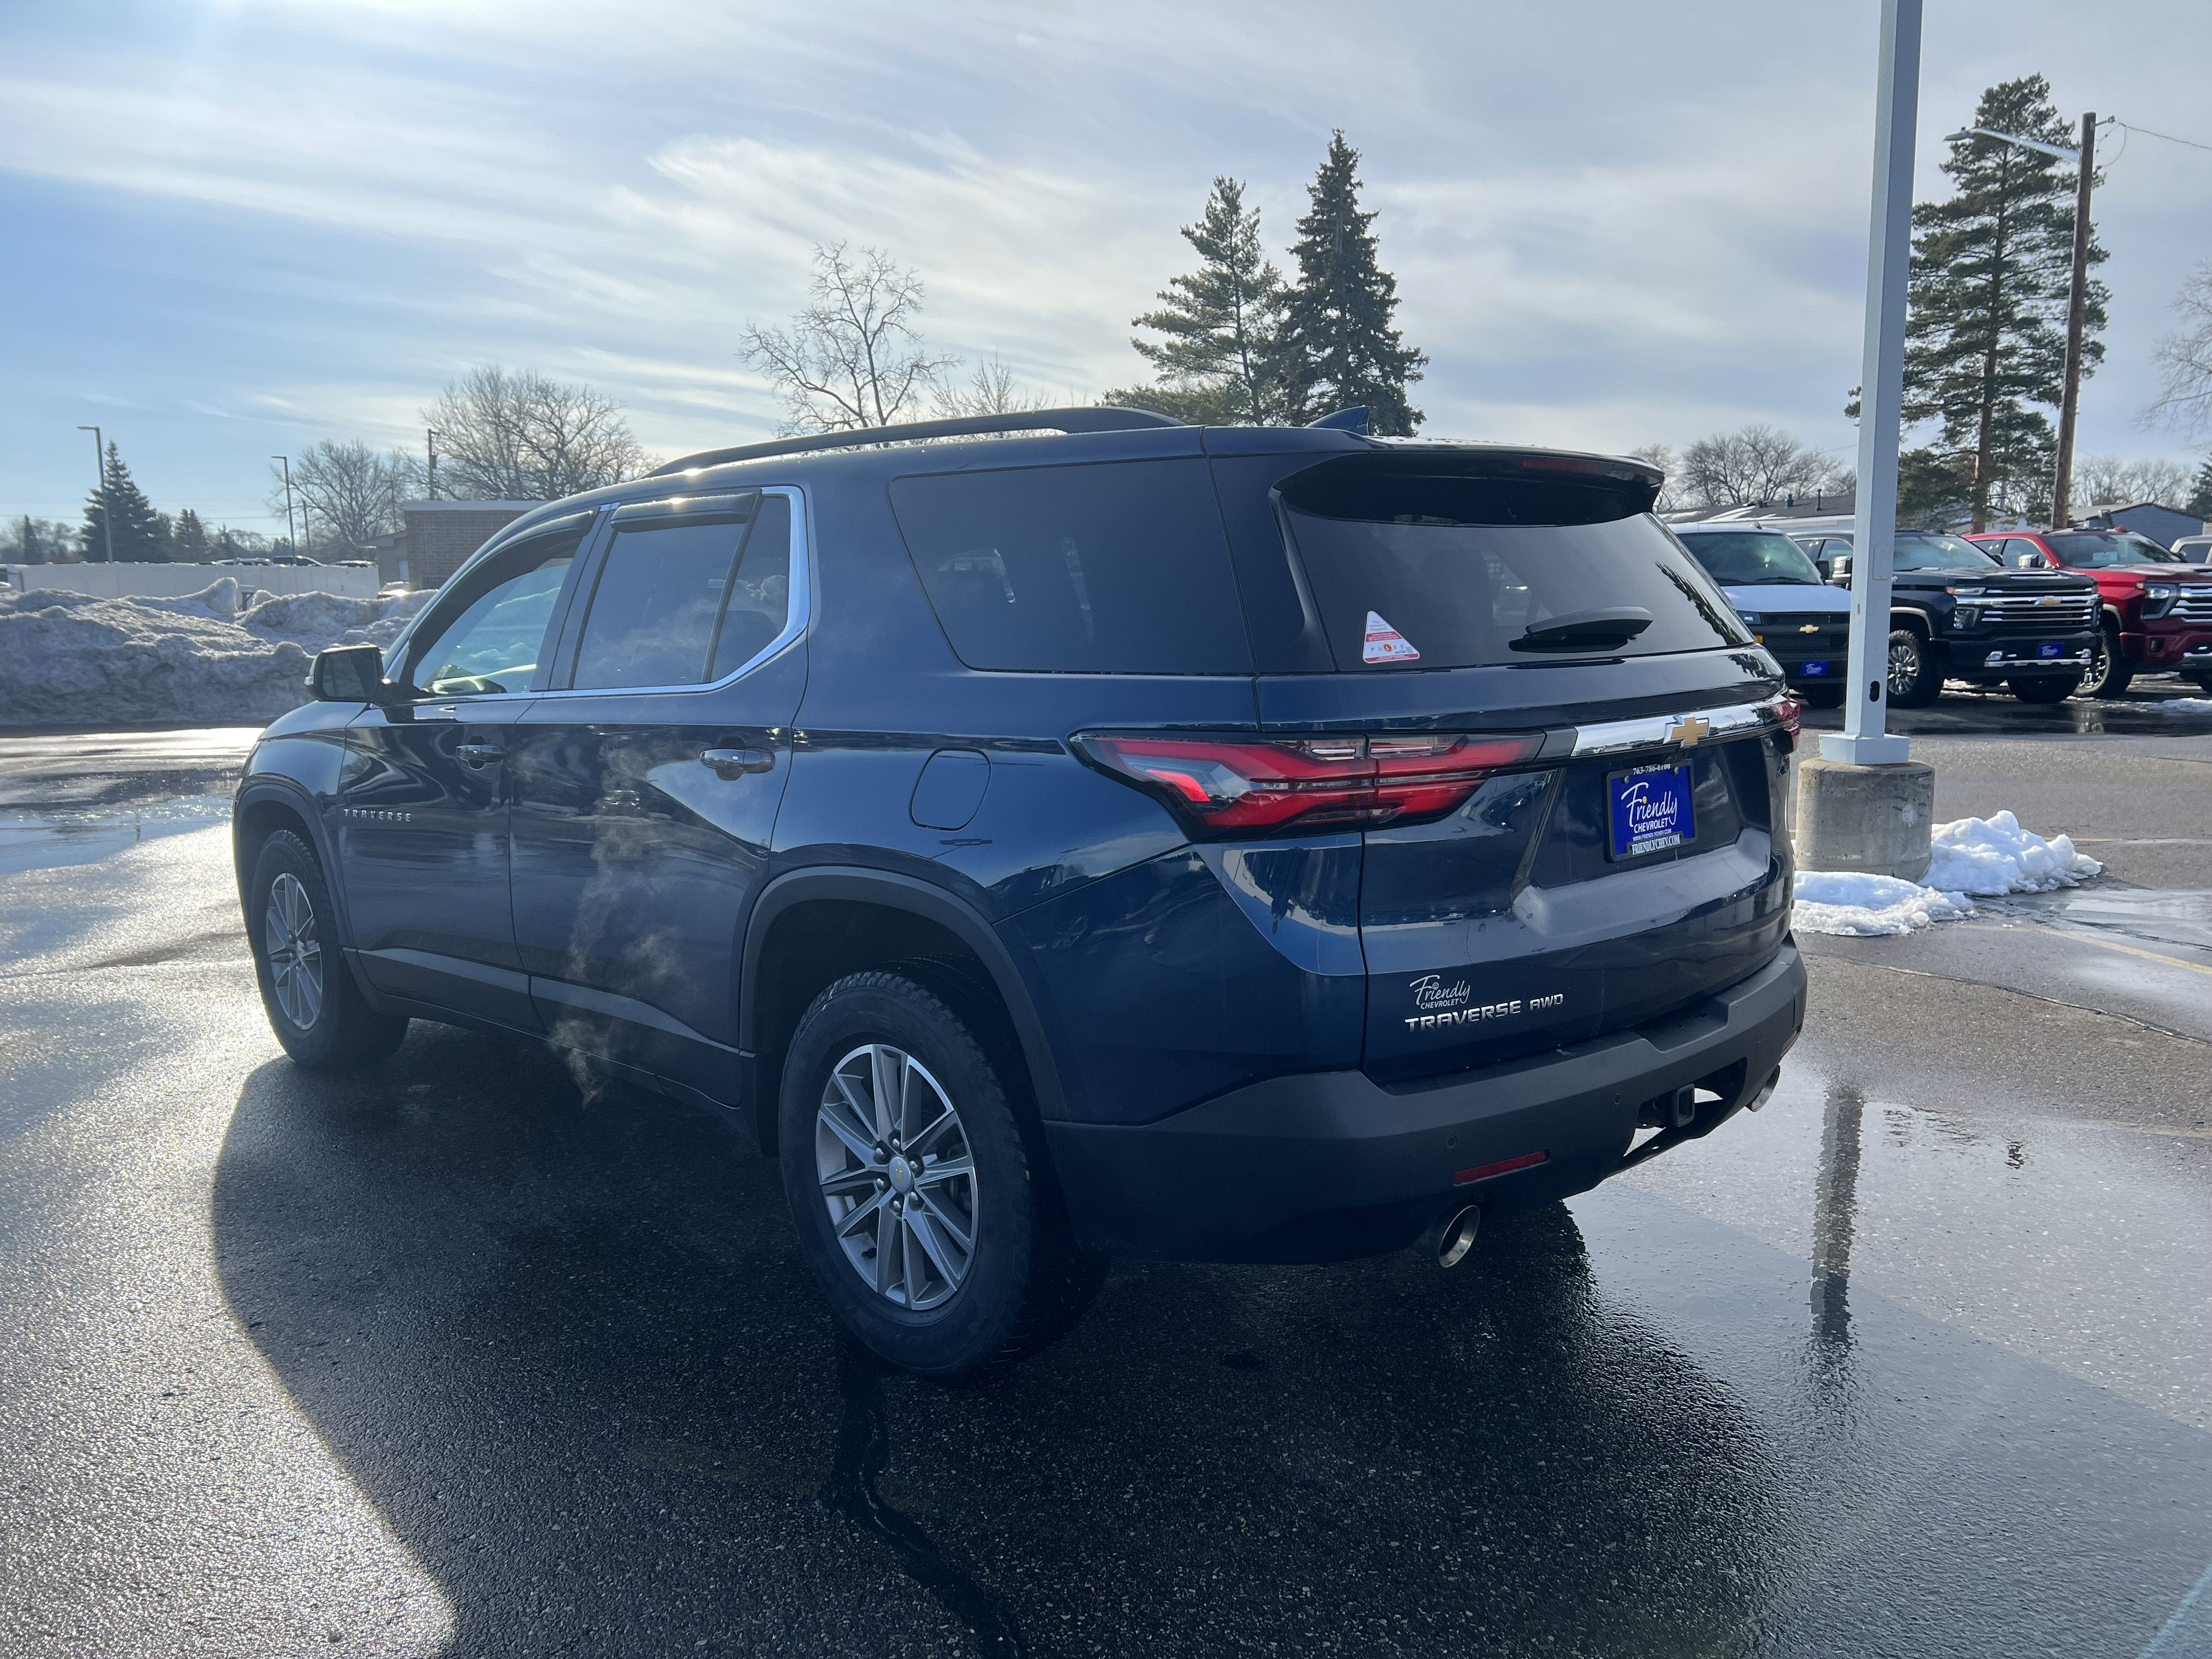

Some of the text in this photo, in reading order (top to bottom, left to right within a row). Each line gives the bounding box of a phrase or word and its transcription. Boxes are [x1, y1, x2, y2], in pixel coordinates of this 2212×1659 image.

[1633, 764, 1671, 776] 763-786-6100
[1621, 782, 1677, 827] Friendly
[343, 808, 411, 822] TRAVERSE
[1633, 817, 1668, 833] CHEVROLET
[1631, 833, 1680, 855] FRIENDLYCHEV.COM
[1409, 974, 1470, 1006] Friendly
[1404, 994, 1564, 1032] TRAVERSE AWD
[1420, 998, 1460, 1010] CHEVROLET
